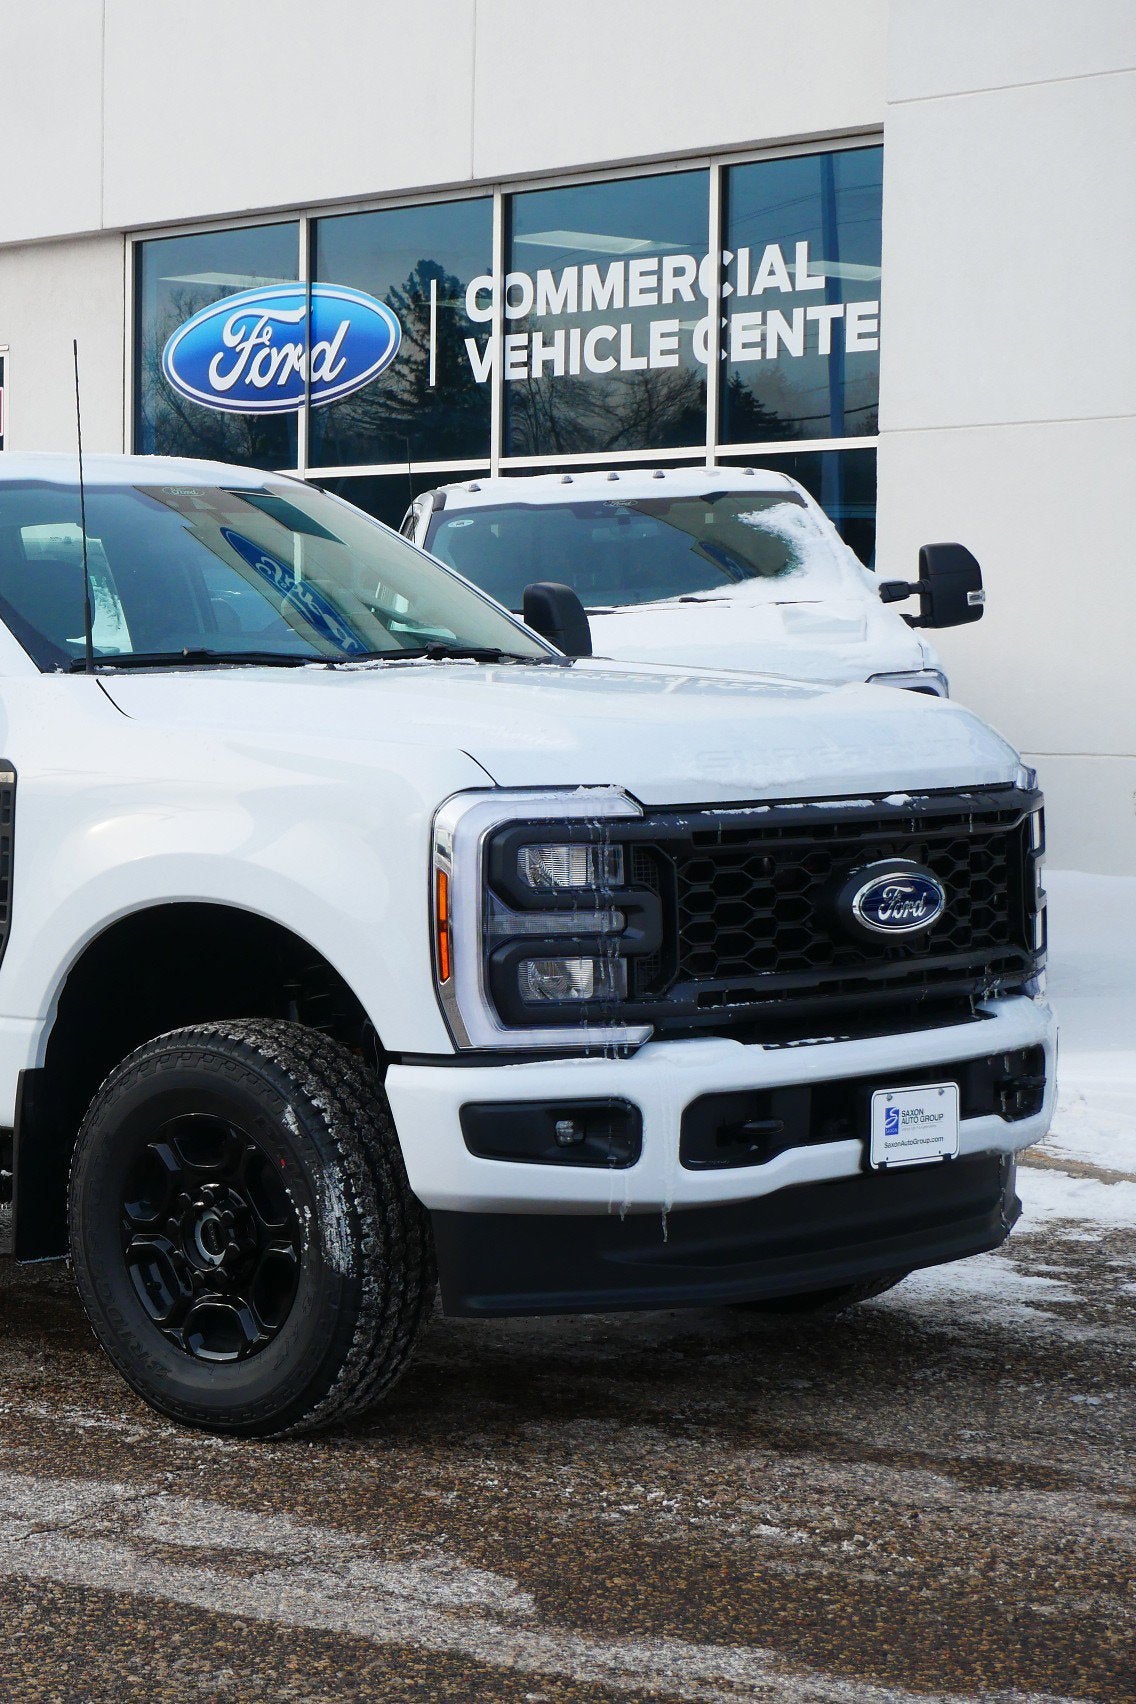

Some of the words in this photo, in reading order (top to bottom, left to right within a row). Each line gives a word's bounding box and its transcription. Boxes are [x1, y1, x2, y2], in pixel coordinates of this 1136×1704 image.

[466, 241, 826, 323] COMMERCIAL
[208, 305, 351, 391] Ford
[464, 319, 680, 384] VEHICLE
[692, 300, 880, 366] CENTE
[878, 886, 927, 920] Ford
[901, 1108, 924, 1117] SAXON
[901, 1116, 919, 1124] AUTO
[920, 1113, 944, 1122] GROUP
[884, 1136, 944, 1148] SaxonAutoGroup.com
